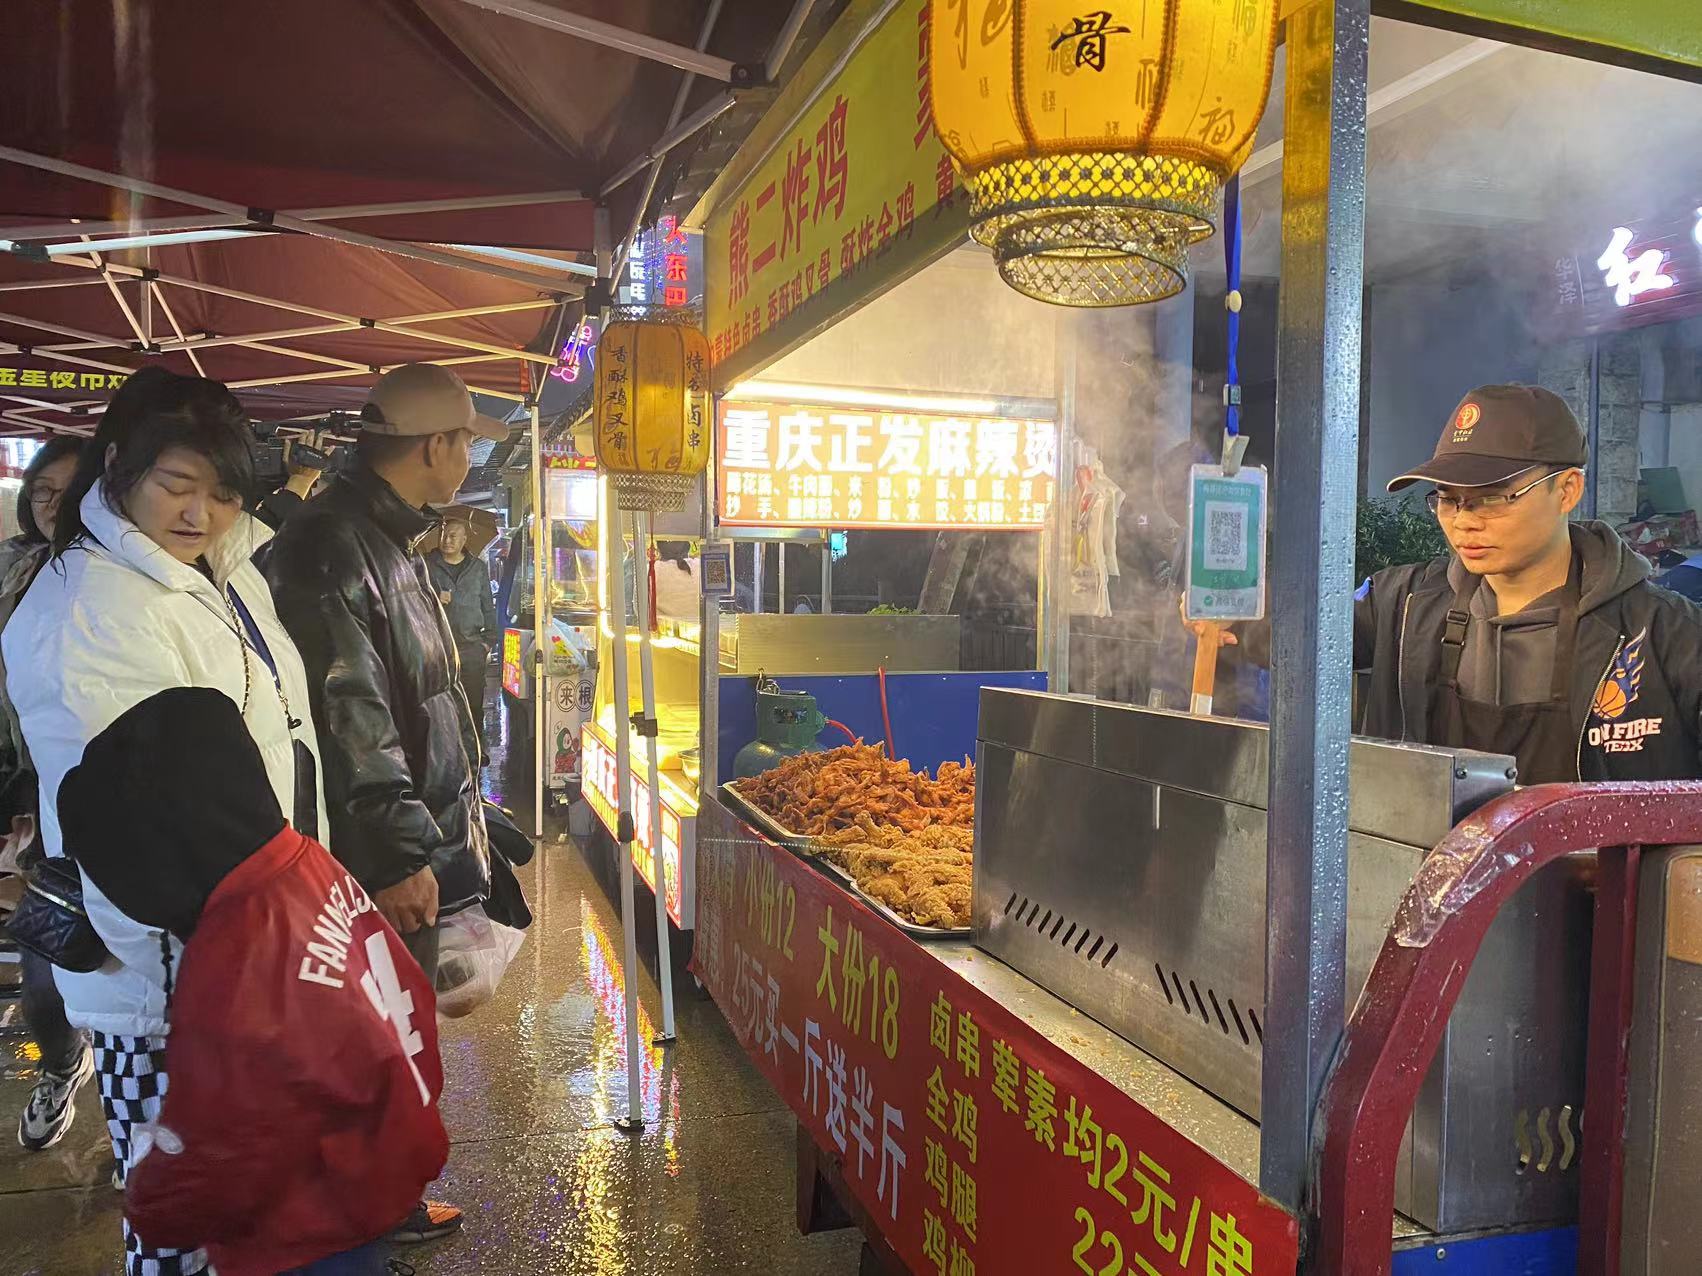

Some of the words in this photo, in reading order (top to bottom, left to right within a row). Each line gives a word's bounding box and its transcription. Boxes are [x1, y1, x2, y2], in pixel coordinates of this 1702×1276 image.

[1051, 11, 1131, 72] 骨
[728, 94, 849, 310] 熊二炸鸡
[767, 248, 831, 332] 香酥鸡叉骨
[840, 181, 915, 278] 酥炸全鸡
[606, 345, 629, 451] 香酥鸡叉骨
[722, 409, 1056, 478] 重庆正发麻辣烫
[1612, 717, 1662, 740] FIRE
[744, 845, 796, 961] 小份12
[816, 905, 900, 1060] 大份18
[732, 942, 906, 1220] 25元买一斤送半斤
[926, 1065, 977, 1163] 全鸡
[930, 990, 980, 1078] 卤串
[991, 1038, 1253, 1276] 荤素均2元/串
[925, 1136, 977, 1243] 鸡腿
